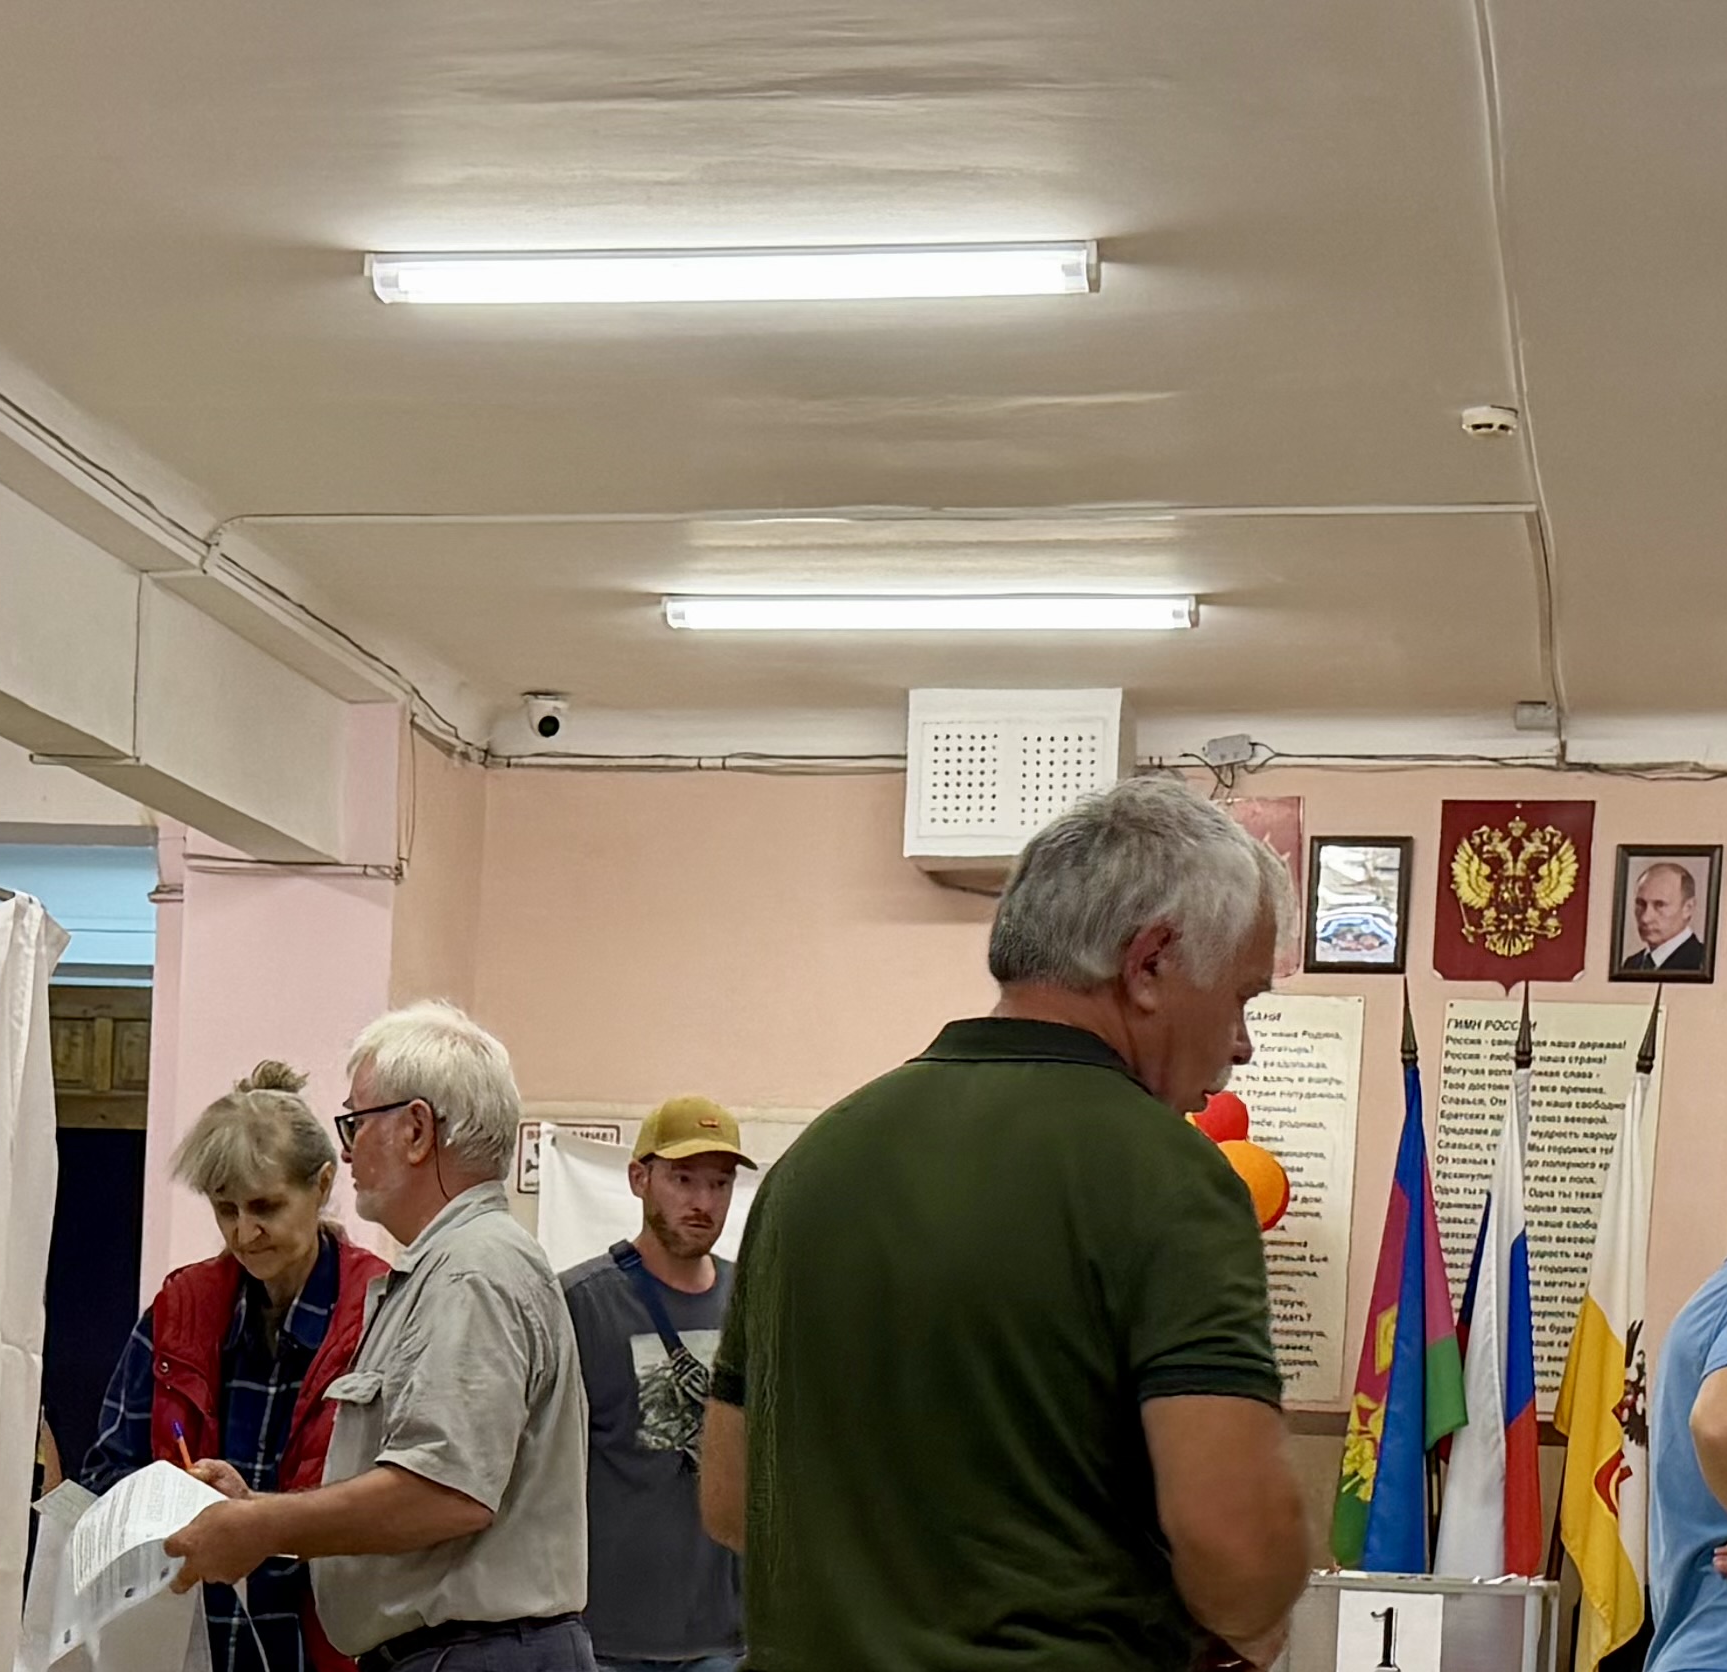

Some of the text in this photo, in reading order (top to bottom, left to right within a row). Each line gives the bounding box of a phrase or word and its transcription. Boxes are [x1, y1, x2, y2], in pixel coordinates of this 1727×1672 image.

[1447, 1018, 1538, 1032] ГИМН РОССИ
[1370, 1606, 1401, 1672] 1
